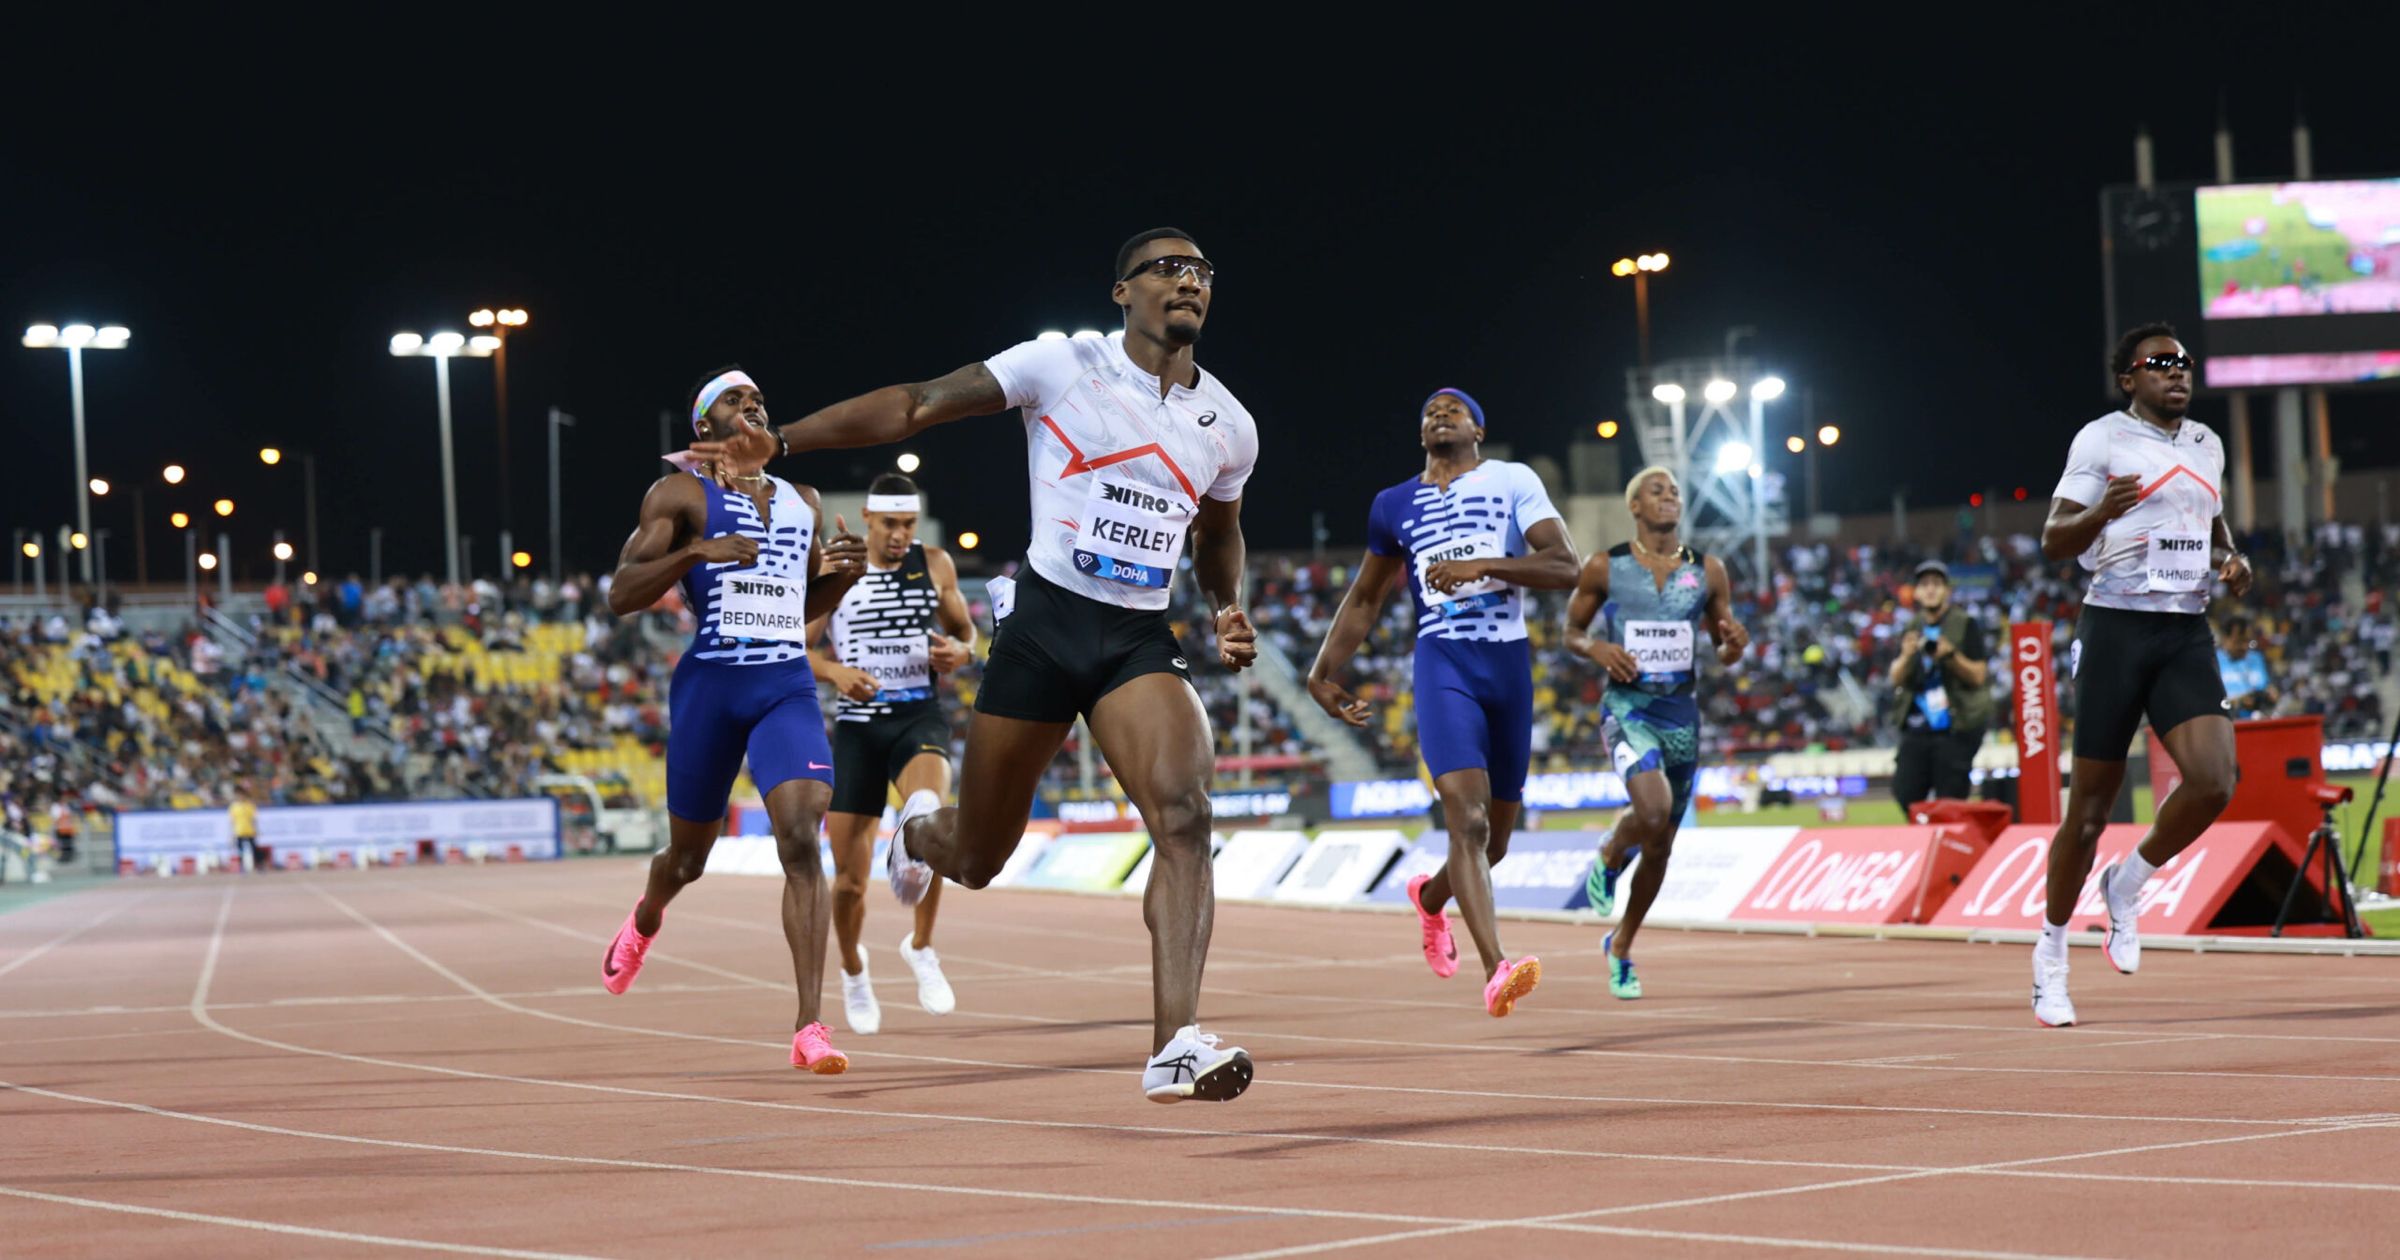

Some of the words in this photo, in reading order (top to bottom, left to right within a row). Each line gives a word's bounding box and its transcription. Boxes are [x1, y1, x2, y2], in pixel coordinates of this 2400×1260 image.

[1100, 482, 1169, 513] NITRO
[1092, 517, 1176, 553] KERLEY
[2158, 539, 2203, 551] NITRO
[1426, 545, 1475, 564] NITRO
[1111, 564, 1149, 582] DOHA
[729, 580, 785, 597] NITRO
[723, 611, 802, 629] BEDNAREK
[1635, 628, 1677, 638] NITRO
[867, 645, 911, 655] NITRO
[2020, 665, 2046, 758] OMEGA
[1788, 849, 1921, 912] OMEGA
